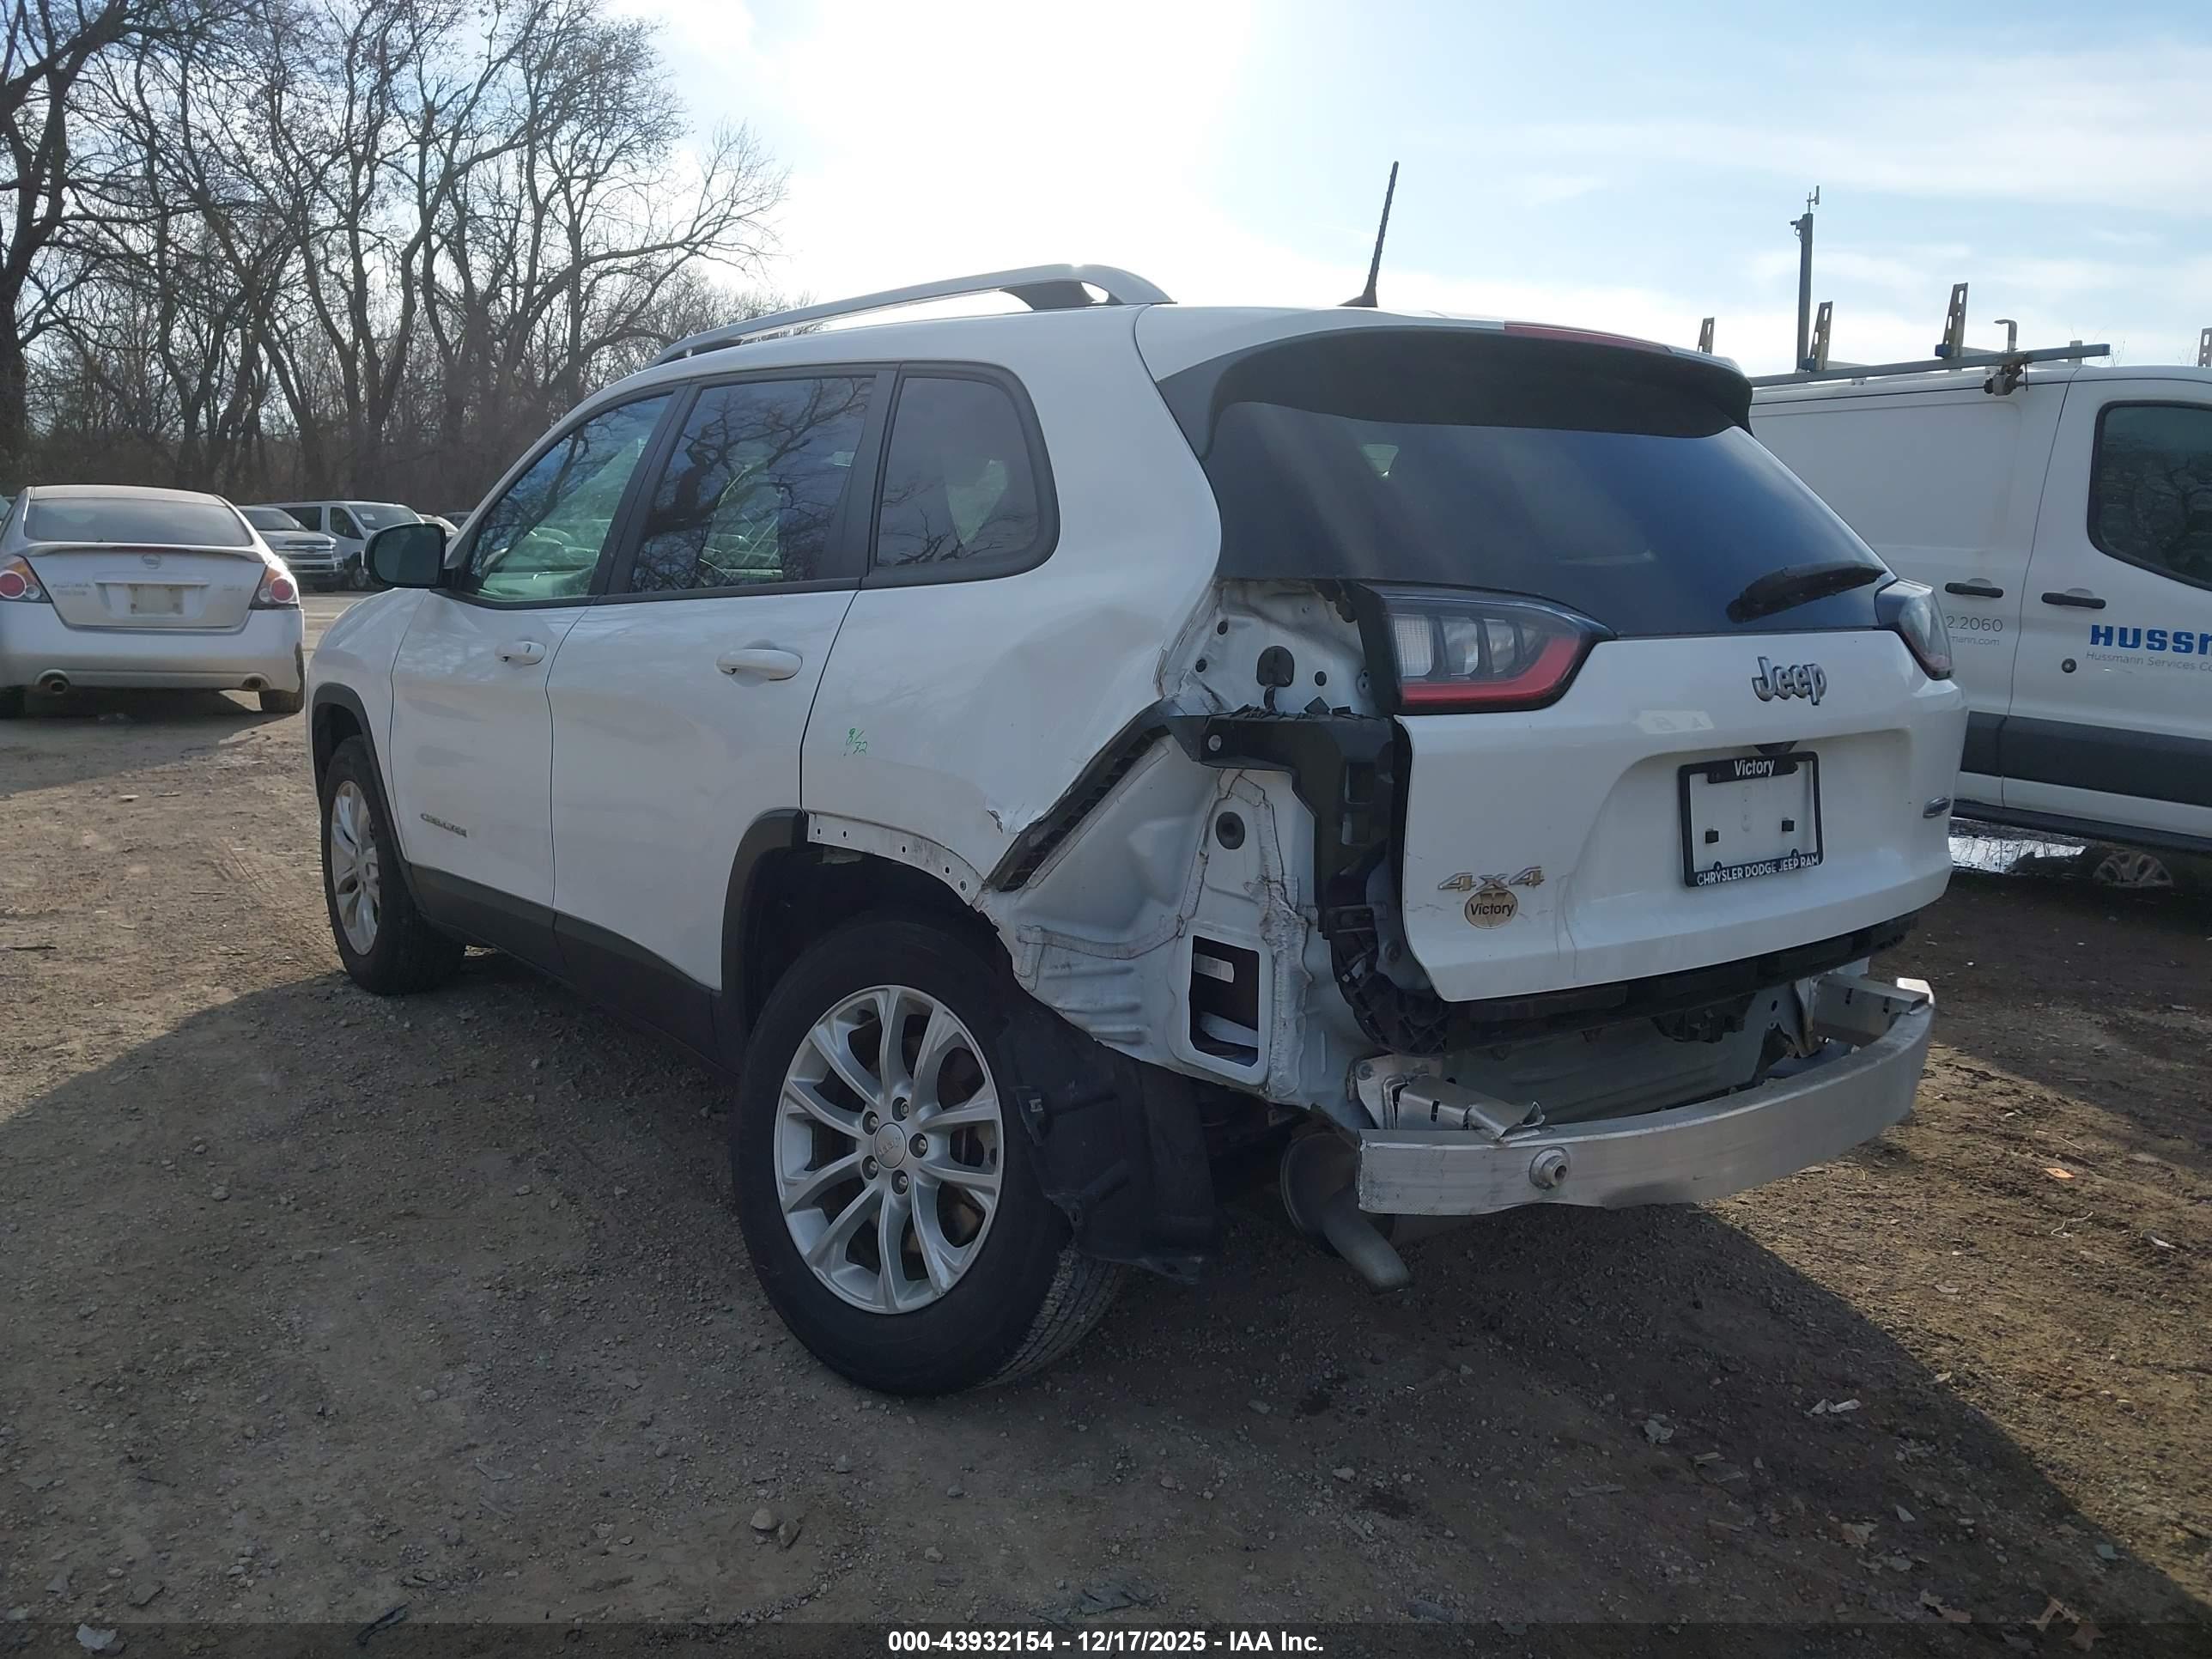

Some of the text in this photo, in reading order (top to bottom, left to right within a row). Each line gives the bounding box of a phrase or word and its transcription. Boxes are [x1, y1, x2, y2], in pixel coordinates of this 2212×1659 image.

[2086, 651, 2144, 665] Hussmann
[2148, 656, 2197, 670] Services
[1751, 655, 1828, 707] Jeep
[1734, 759, 1775, 777] Victory
[1697, 854, 1820, 886] CHRYSLER DODGE JEEP RAM
[1470, 902, 1516, 917] Victory
